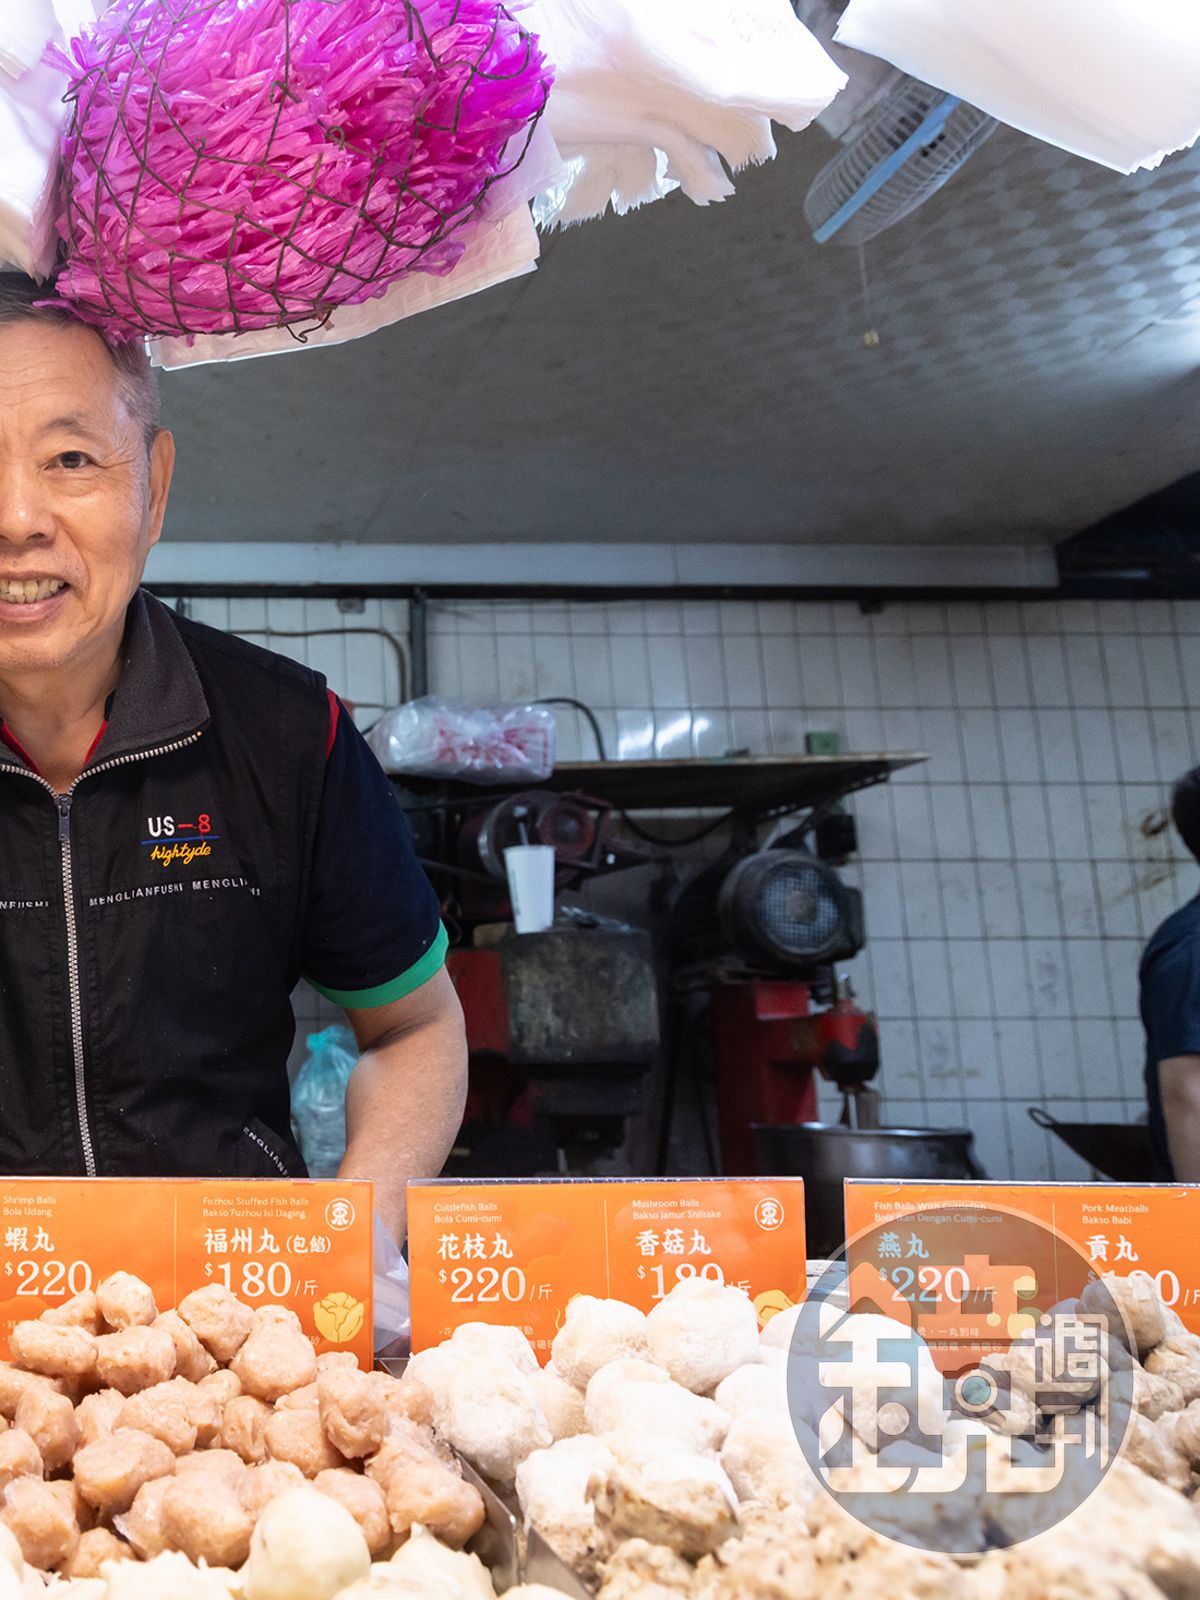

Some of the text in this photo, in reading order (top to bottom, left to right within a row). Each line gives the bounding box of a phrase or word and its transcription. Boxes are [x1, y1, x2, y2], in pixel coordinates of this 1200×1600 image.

[150, 841, 212, 867] hightyde
[89, 882, 184, 907] MENGLIANFUSHI
[3, 1195, 56, 1206] Shrimp Balls
[202, 1197, 310, 1206] Fuzhou Stuffed Fish Balls
[632, 1199, 700, 1208] Mushroom Balls
[874, 1201, 892, 1210] Fish
[894, 1202, 914, 1210] Balls
[917, 1202, 940, 1210] With
[3, 1207, 52, 1218] Bola Udang
[434, 1202, 498, 1212] Cuttlefish Balls
[1082, 1203, 1149, 1213] Pork Meatballs
[202, 1209, 229, 1217] Bakso
[231, 1209, 261, 1217] Fuzhou
[276, 1209, 306, 1219] Daging
[434, 1214, 502, 1224] Bola Cumi-cumi
[633, 1211, 658, 1219] Bakso
[660, 1211, 685, 1220] Jamur
[874, 1213, 895, 1222] Bola
[917, 1213, 951, 1225] Dengan
[953, 1214, 1003, 1223] Cumi-cumi
[1082, 1215, 1132, 1225] Bakso Babi
[4, 1225, 55, 1253] 蝦丸
[636, 1227, 712, 1256] 香菇丸
[437, 1232, 513, 1260] 花枝丸
[878, 1231, 930, 1259] 燕丸
[1085, 1233, 1139, 1262] 貢丸
